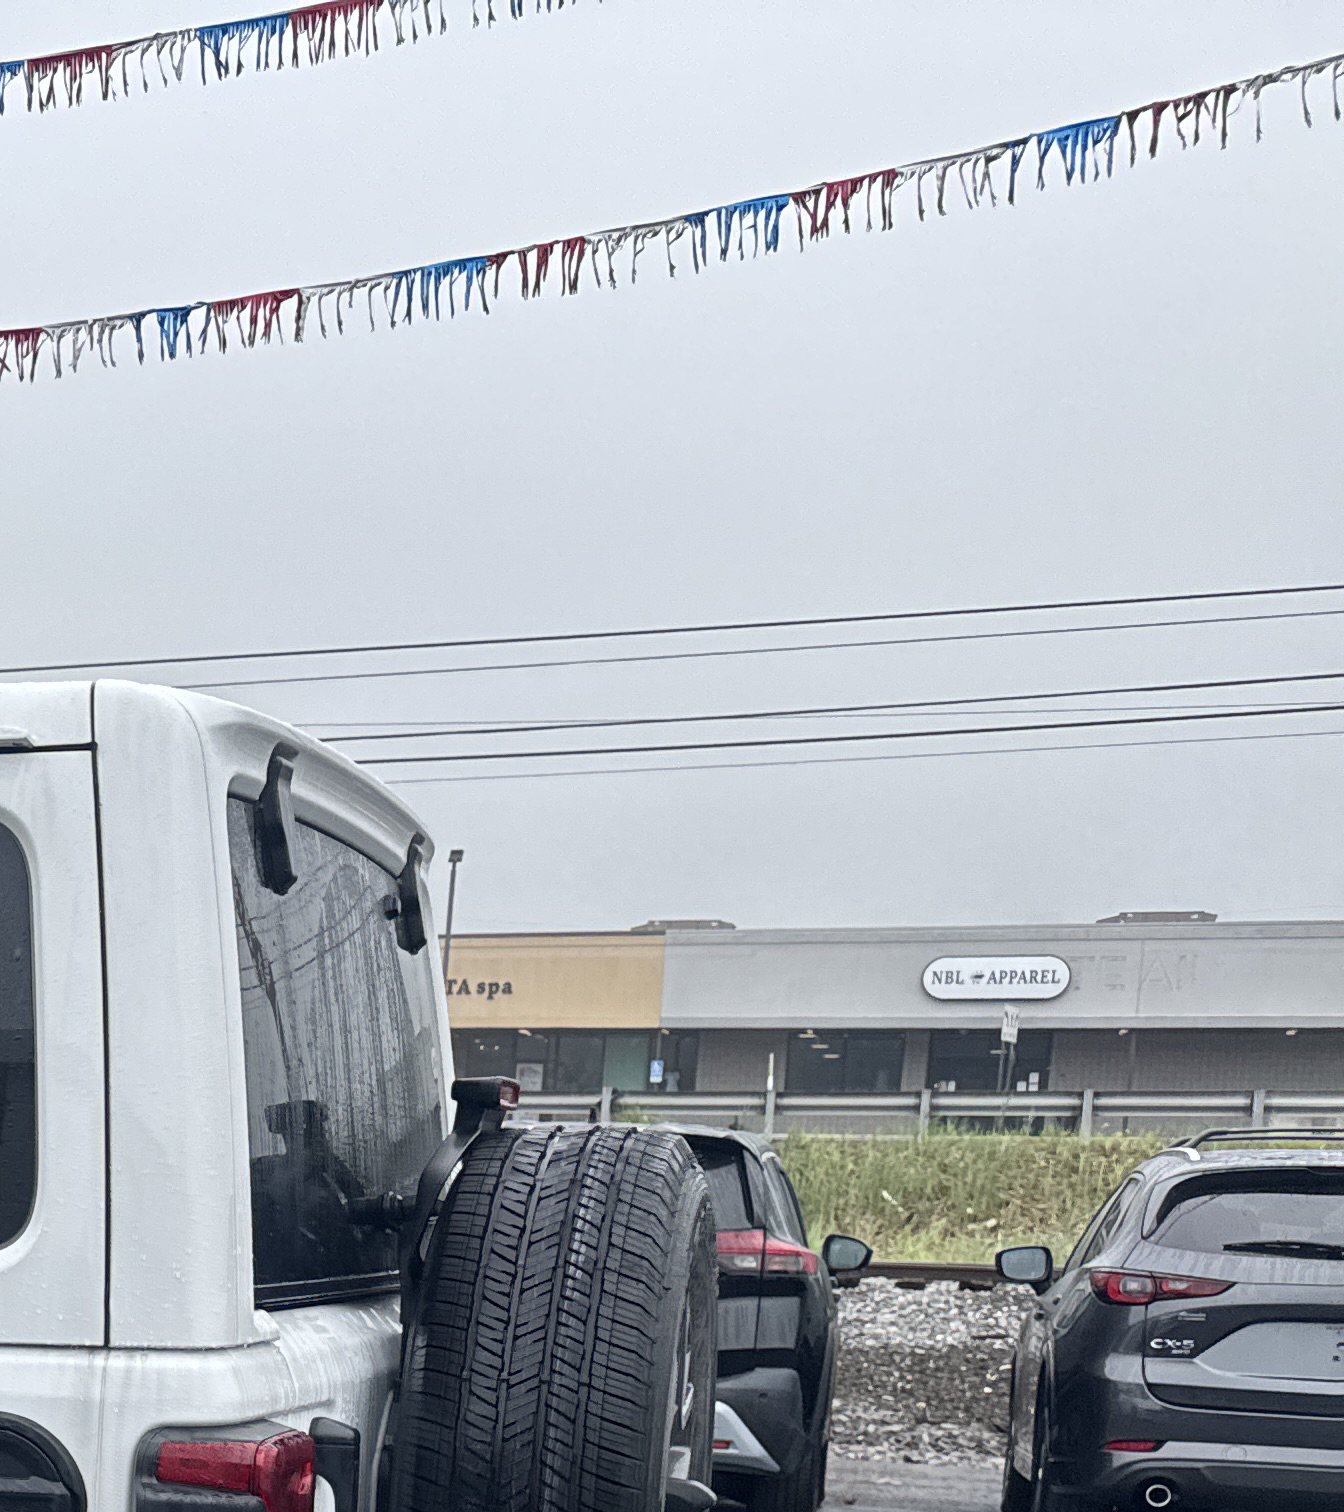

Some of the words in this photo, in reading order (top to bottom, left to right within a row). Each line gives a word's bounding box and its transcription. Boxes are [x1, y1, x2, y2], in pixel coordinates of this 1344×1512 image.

[931, 970, 965, 985] NBL
[986, 969, 1061, 985] APPAREL
[476, 981, 513, 1001] spa
[1150, 1337, 1195, 1350] CX-5
